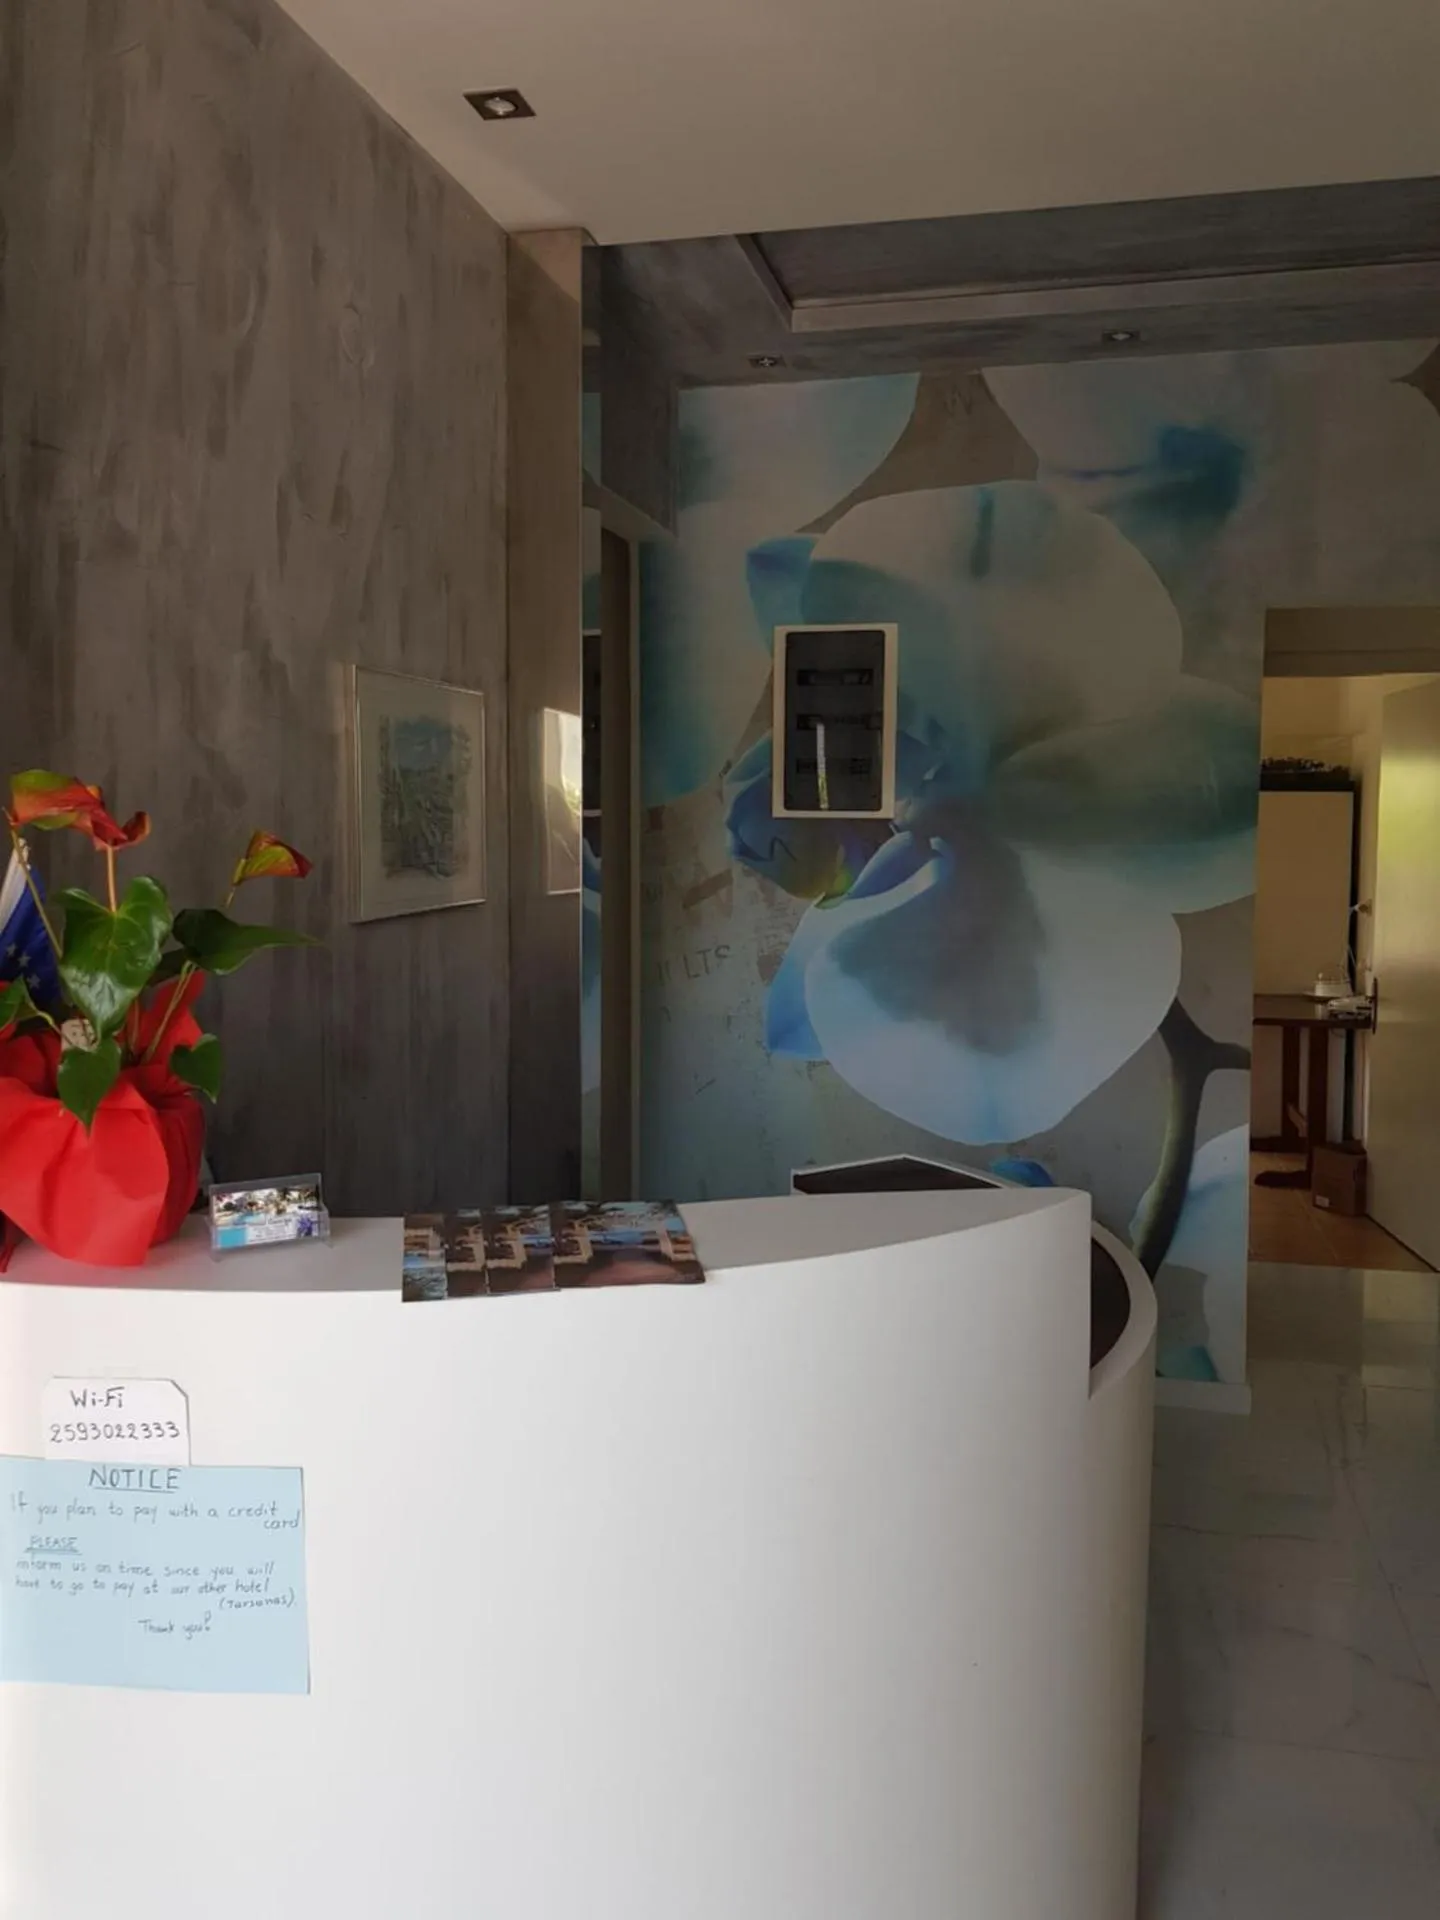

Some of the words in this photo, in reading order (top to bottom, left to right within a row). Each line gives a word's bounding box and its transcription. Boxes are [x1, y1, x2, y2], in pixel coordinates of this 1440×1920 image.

[70, 1387, 124, 1408] Wi-Fi
[50, 1420, 180, 1443] 2593022333
[89, 1465, 181, 1490] NOTICE
[11, 1491, 29, 1512] If
[36, 1505, 58, 1525] you
[66, 1498, 97, 1521] plan
[108, 1501, 124, 1516] to
[133, 1504, 157, 1525] pay
[168, 1499, 198, 1517] with
[207, 1506, 219, 1518] a
[228, 1501, 278, 1517] credit
[263, 1507, 300, 1530] card
[29, 1536, 79, 1550] PLEASE
[72, 1562, 87, 1573] us
[96, 1563, 112, 1574] on
[118, 1560, 153, 1576] time
[164, 1564, 200, 1577] since
[210, 1566, 234, 1582] you
[247, 1561, 275, 1576] will
[49, 1578, 64, 1590] to
[69, 1582, 85, 1596] go
[92, 1578, 106, 1590] to
[113, 1582, 135, 1597] pay
[143, 1581, 159, 1594] at
[235, 1577, 271, 1593] hotel
[138, 1618, 175, 1633] Thank
